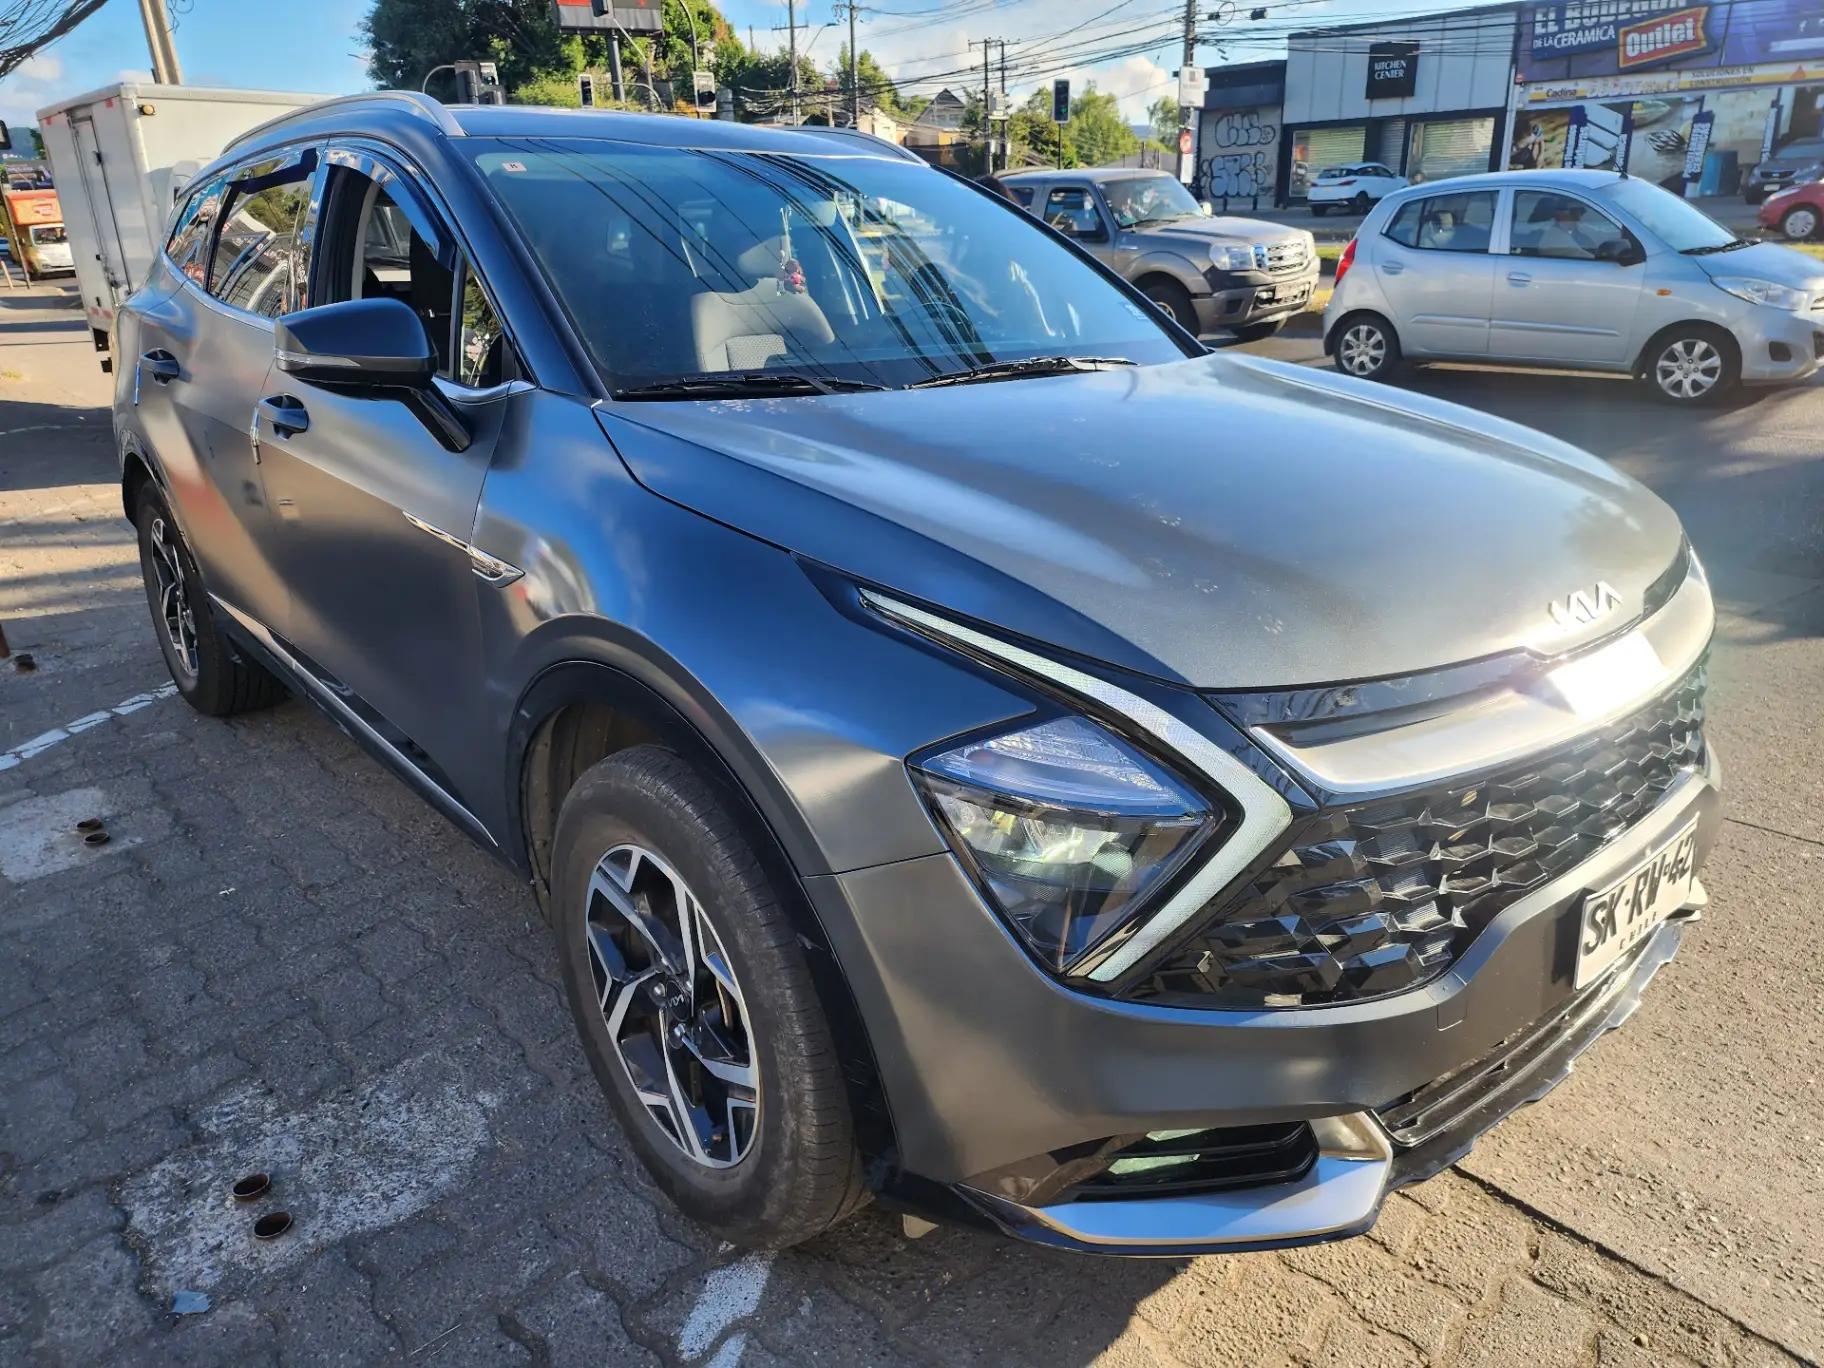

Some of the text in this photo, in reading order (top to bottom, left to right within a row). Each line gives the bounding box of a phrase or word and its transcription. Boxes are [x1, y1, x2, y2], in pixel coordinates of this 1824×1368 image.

[1534, 7, 1559, 35] EL
[1533, 25, 1617, 49] DE LA CERAMICA
[1626, 18, 1695, 57] Outlet
[1375, 69, 1405, 80] CENTER
